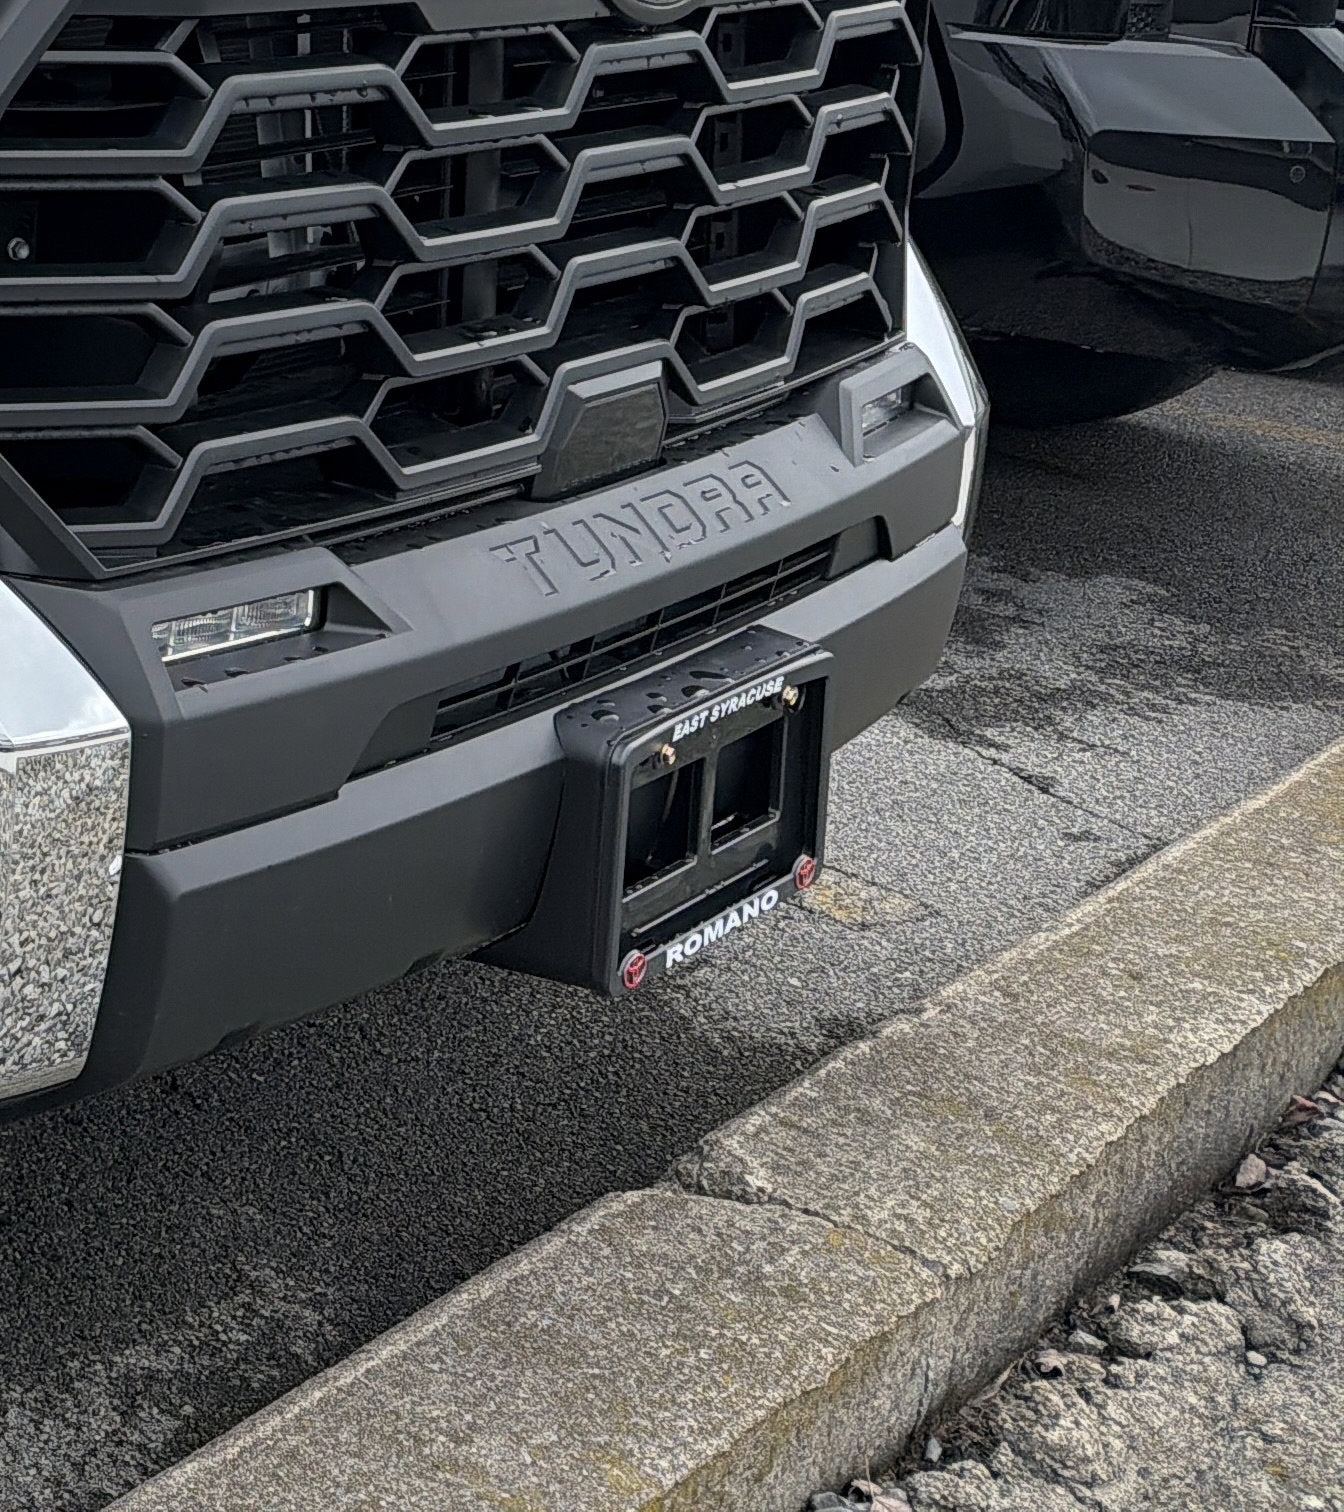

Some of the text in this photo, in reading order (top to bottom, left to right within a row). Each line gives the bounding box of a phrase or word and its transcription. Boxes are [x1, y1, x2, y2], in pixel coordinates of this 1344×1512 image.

[489, 460, 792, 597] TUNDRA
[672, 675, 785, 743] EAST SYRACUSE
[665, 889, 779, 968] ROMANO
